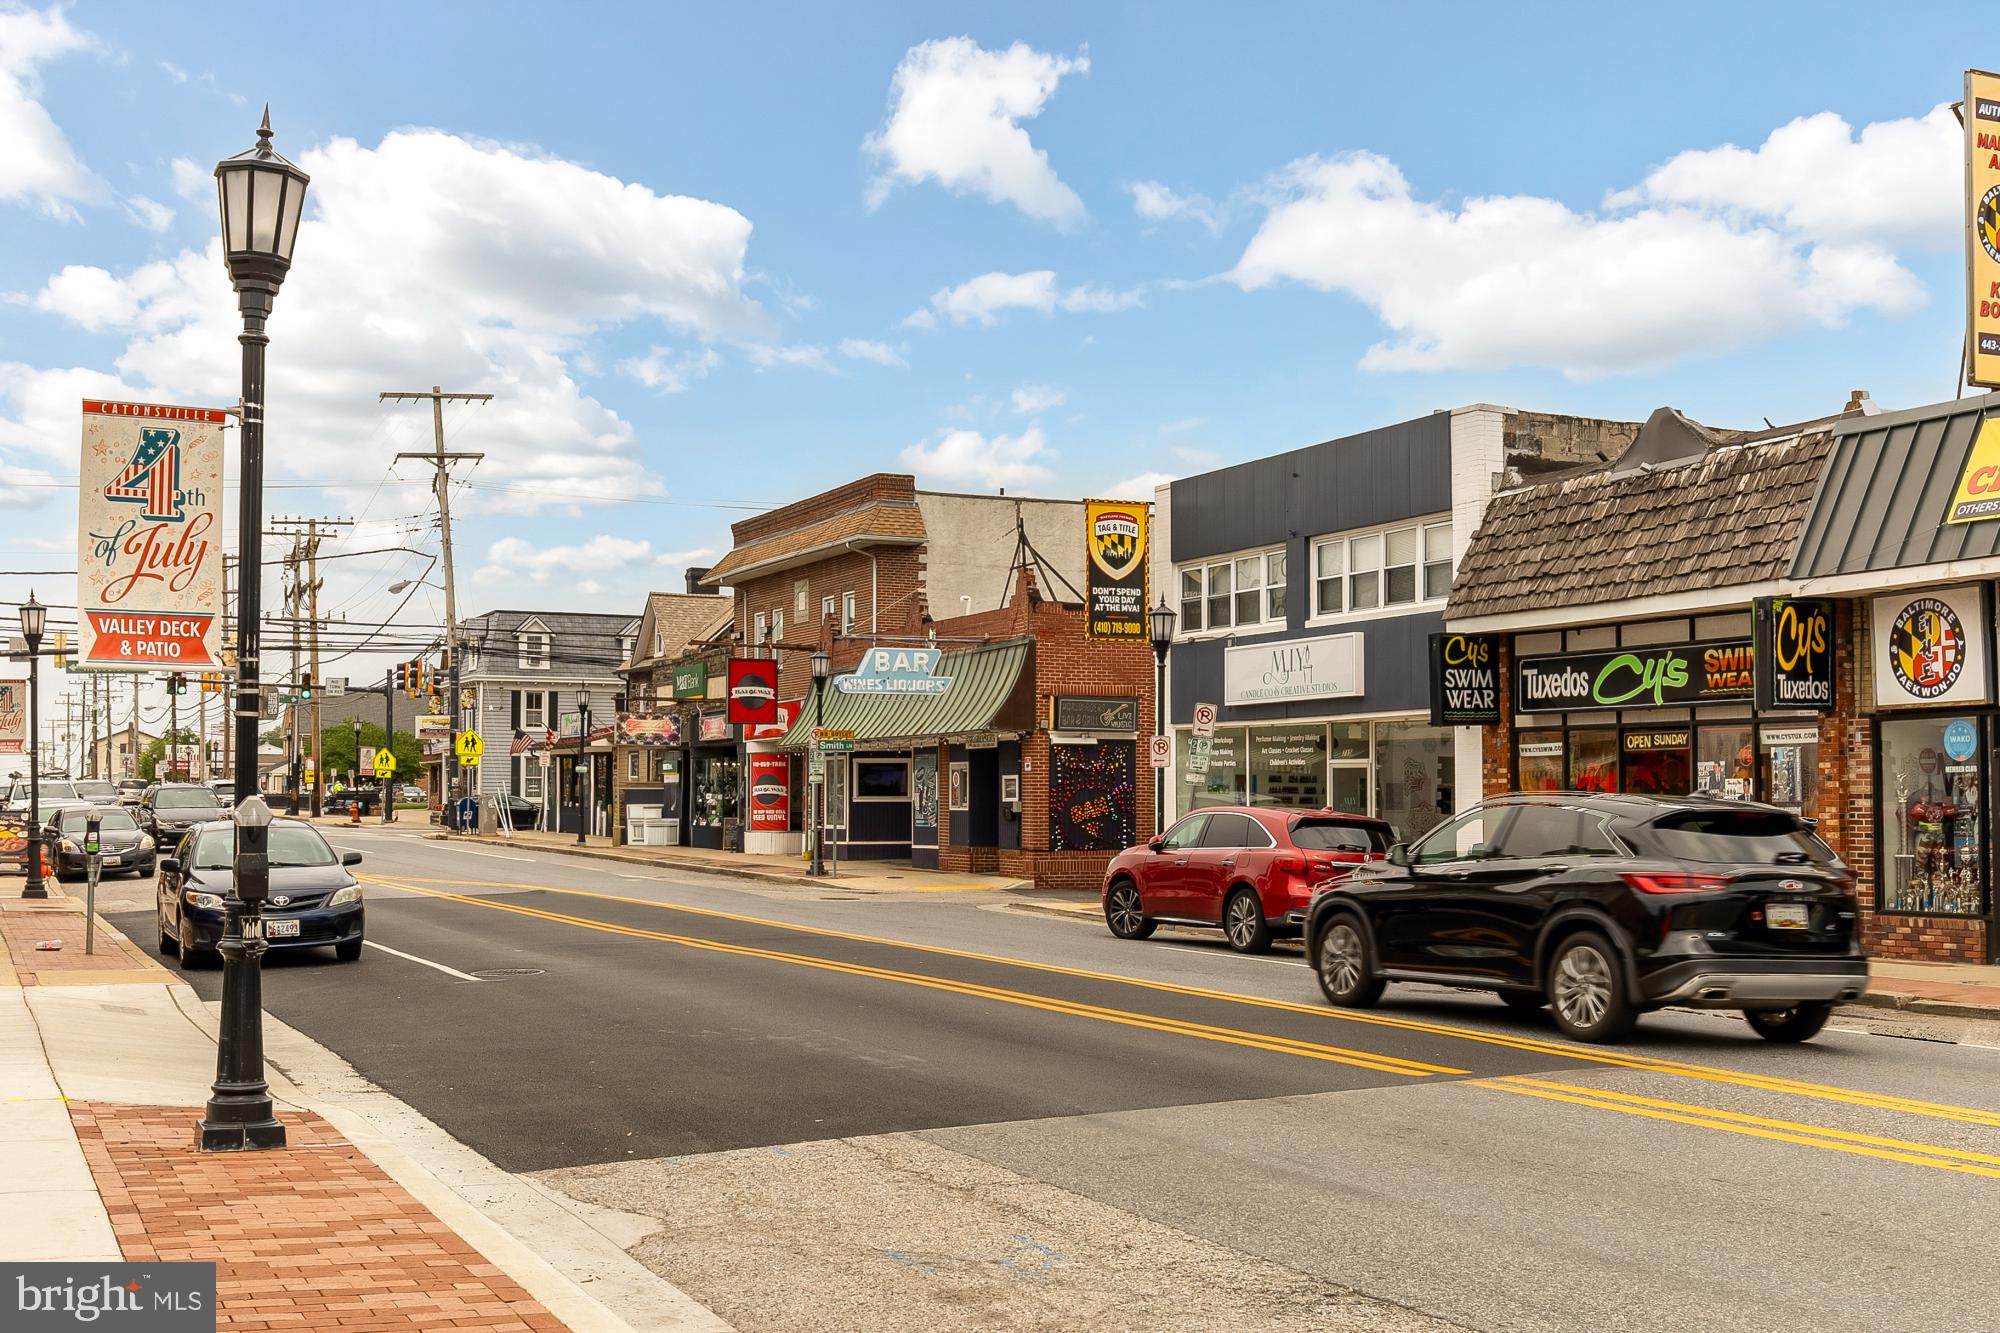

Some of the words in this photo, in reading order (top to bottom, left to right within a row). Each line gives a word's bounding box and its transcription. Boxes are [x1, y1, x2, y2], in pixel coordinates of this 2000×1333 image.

[1977, 132, 2000, 151] MA
[101, 403, 211, 421] CATONSVILLE
[1957, 501, 2000, 515] OTHERS
[1097, 523, 1111, 533] TAG
[1112, 523, 1118, 531] &
[1119, 523, 1136, 534] TITLE
[88, 519, 137, 567] of
[100, 512, 214, 604] July
[1092, 587, 1116, 595] DON'T
[1117, 587, 1142, 596] SPEND
[1098, 595, 1120, 604] YOUR
[1121, 596, 1136, 604] DAY
[1094, 603, 1105, 611] AT
[1106, 604, 1121, 612] THE
[1121, 604, 1140, 613] MVA!
[1896, 600, 1956, 628] BALTIMORE
[98, 617, 156, 637] VALLEY
[160, 620, 201, 638] DECK
[1093, 621, 1111, 634] (410)
[1777, 603, 1826, 674] Cy's
[120, 639, 132, 656] &
[137, 640, 181, 658] PATIO
[1445, 636, 1489, 668] Cy's
[875, 651, 930, 673] BAR
[842, 678, 882, 691] WINES
[885, 679, 945, 692] LIQUORS
[1444, 668, 1494, 688] SWIM
[1522, 666, 1589, 699] Tuxedos
[1593, 650, 1689, 706] Cy's
[1706, 671, 1754, 688] WEA
[1777, 673, 1829, 700] Tuxedos
[1896, 663, 1961, 697] TAEKWON-DO
[1240, 688, 1263, 699] CANDLE
[1281, 683, 1309, 696] CREATIVE
[1311, 682, 1338, 694] STUDIOS
[1445, 689, 1495, 709] WEAR
[1110, 719, 1133, 729] MUSIC
[1117, 712, 1133, 720] LIVE
[1627, 735, 1651, 748] OPEN
[1654, 734, 1688, 746] SUNDAY
[1765, 732, 1818, 740] WWW.CYSTUX.COM
[1950, 735, 1971, 743] WAKO
[820, 741, 845, 750] Smith
[1520, 745, 1562, 753] WWW.CYSSWIM.CO
[1965, 765, 1978, 773] CLUB
